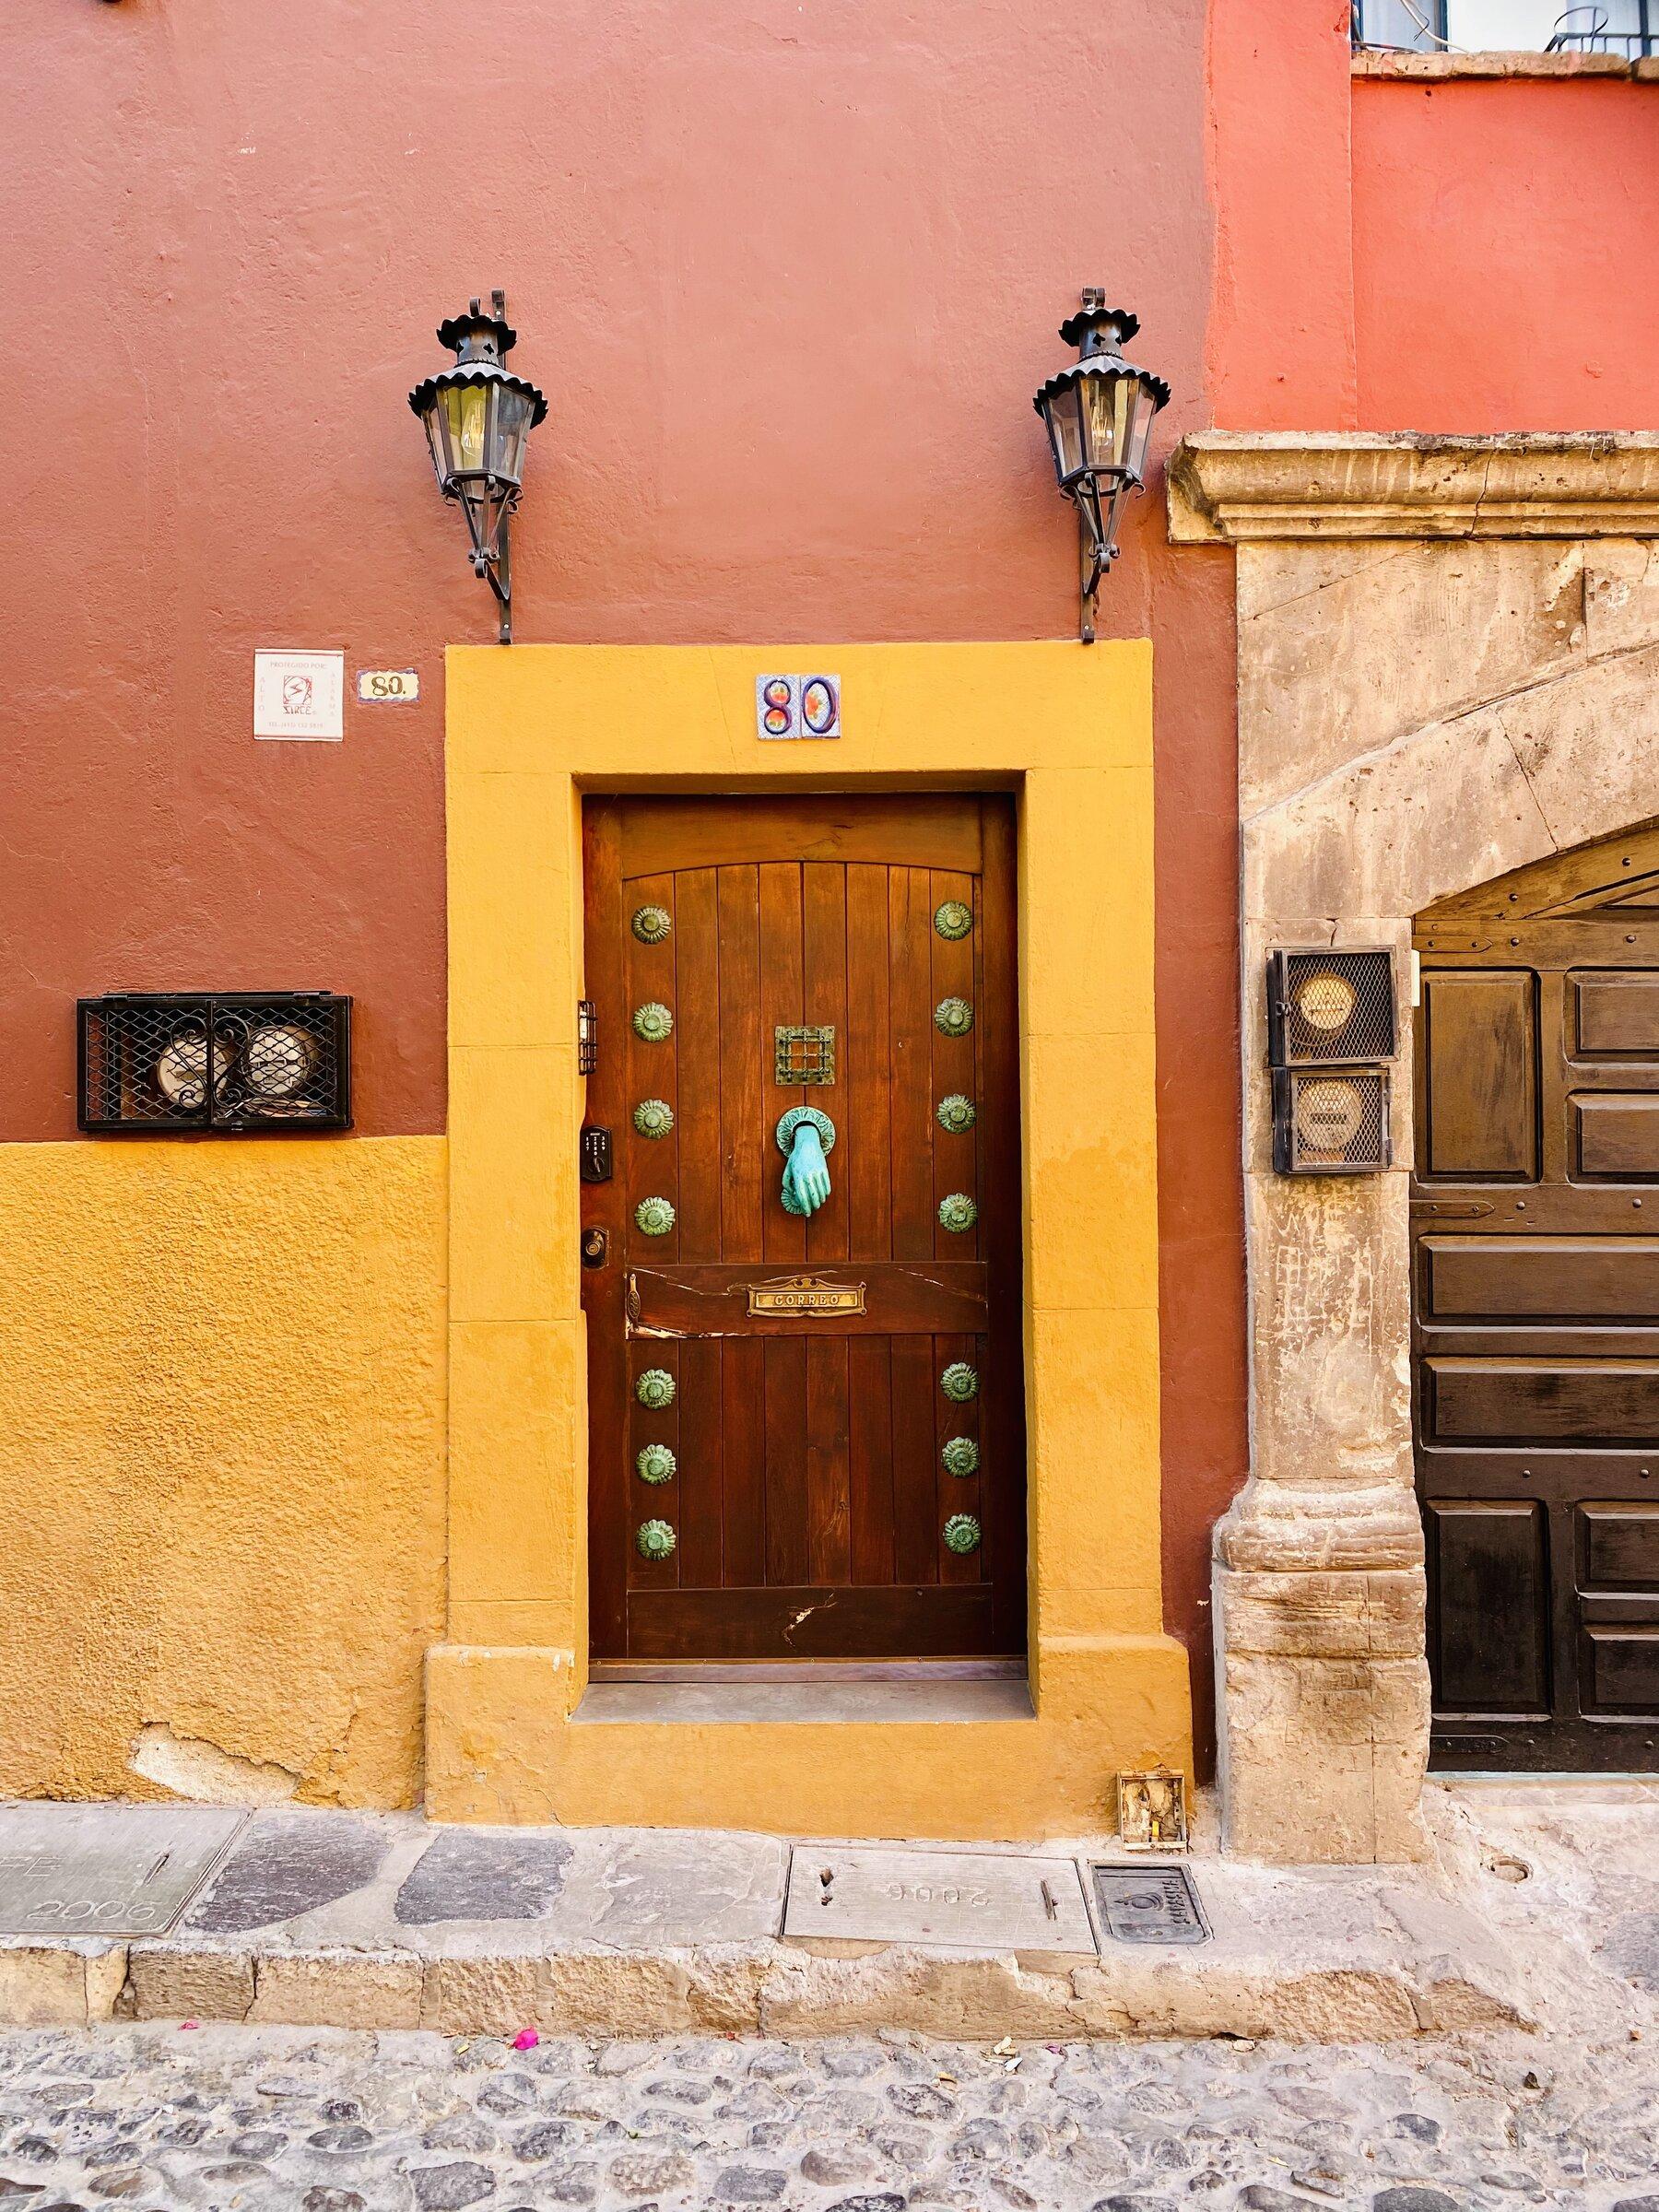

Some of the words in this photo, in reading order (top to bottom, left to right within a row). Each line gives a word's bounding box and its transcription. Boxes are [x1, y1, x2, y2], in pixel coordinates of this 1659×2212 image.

[763, 677, 838, 735] 80
[774, 1295, 840, 1305] CORREO
[27, 1900, 162, 1921] 2006
